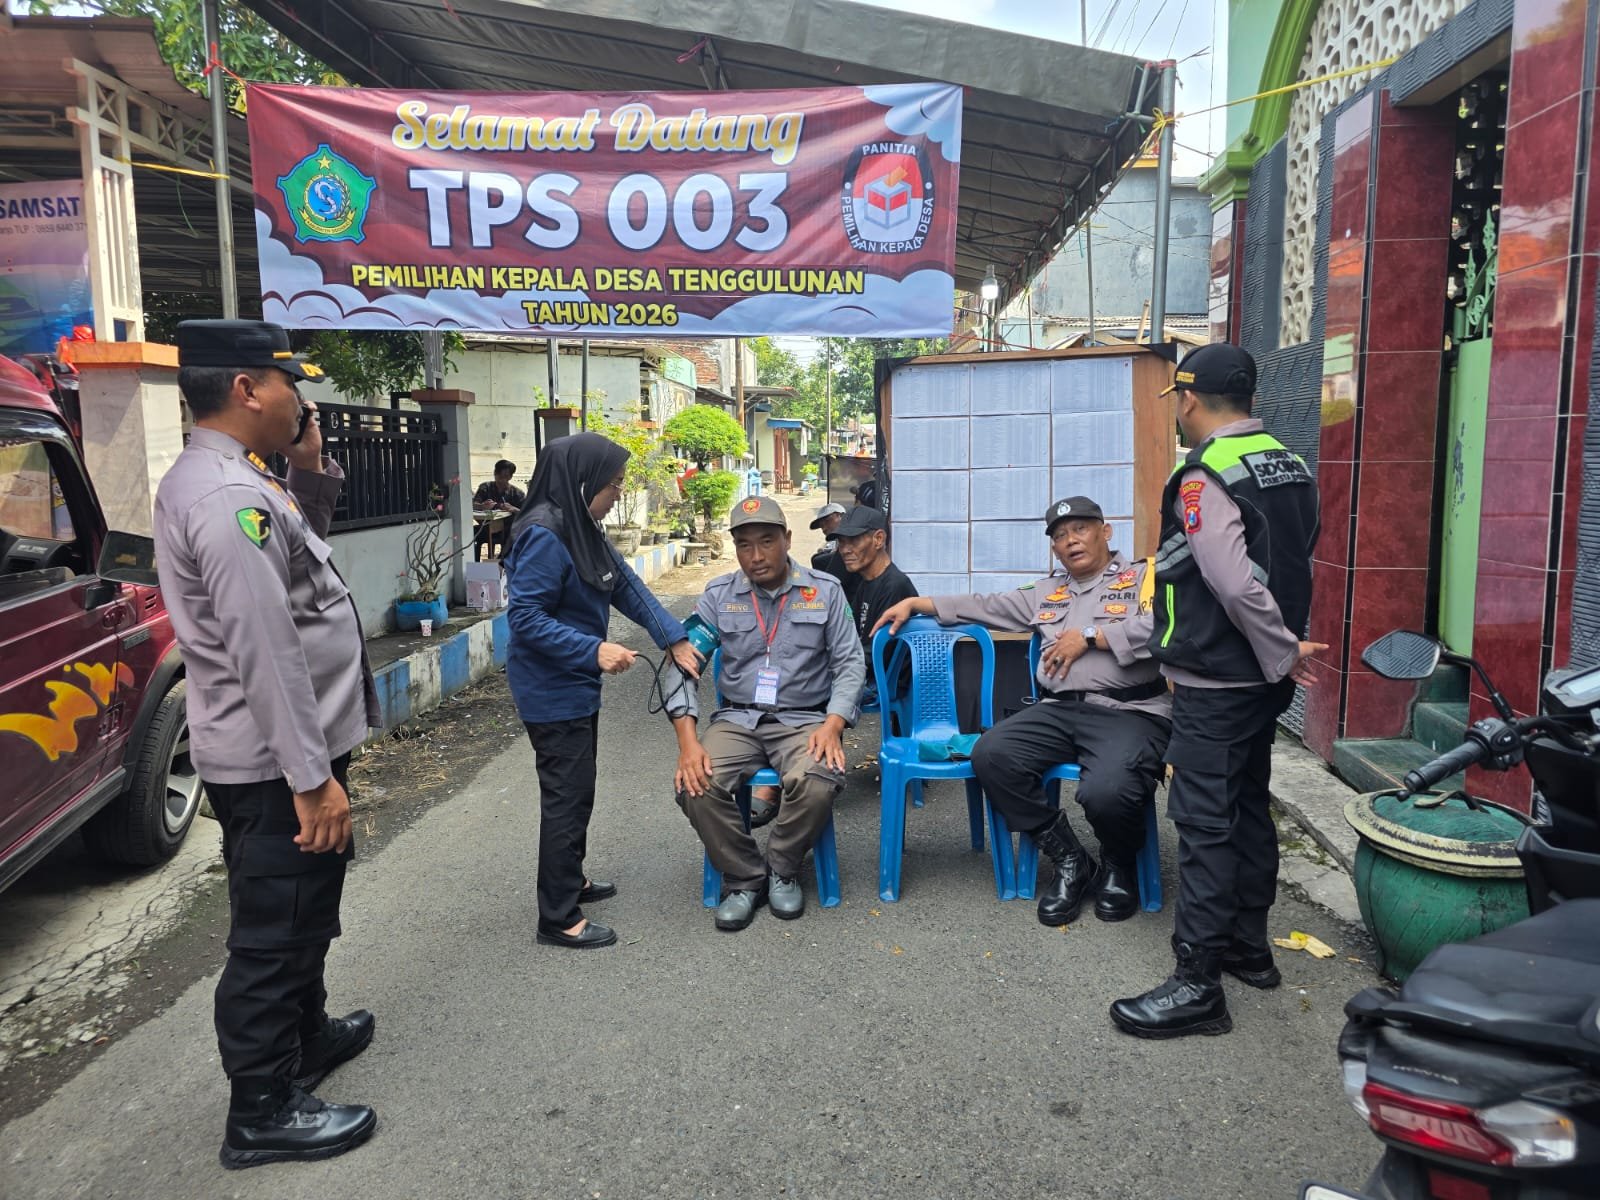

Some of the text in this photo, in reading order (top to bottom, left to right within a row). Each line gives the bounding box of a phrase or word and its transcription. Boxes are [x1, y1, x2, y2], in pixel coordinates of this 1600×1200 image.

[392, 101, 804, 166] Selamat Datang
[862, 142, 917, 156] PANITIA
[409, 169, 788, 251] TPS 003
[841, 196, 934, 253] PEMILIHAN KEPALA DESA
[351, 265, 864, 293] PEMILIHAN KEPALA DESA TENGGULUNAN
[522, 302, 678, 325] TAHUN 2026
[1099, 591, 1136, 602] POLRI
